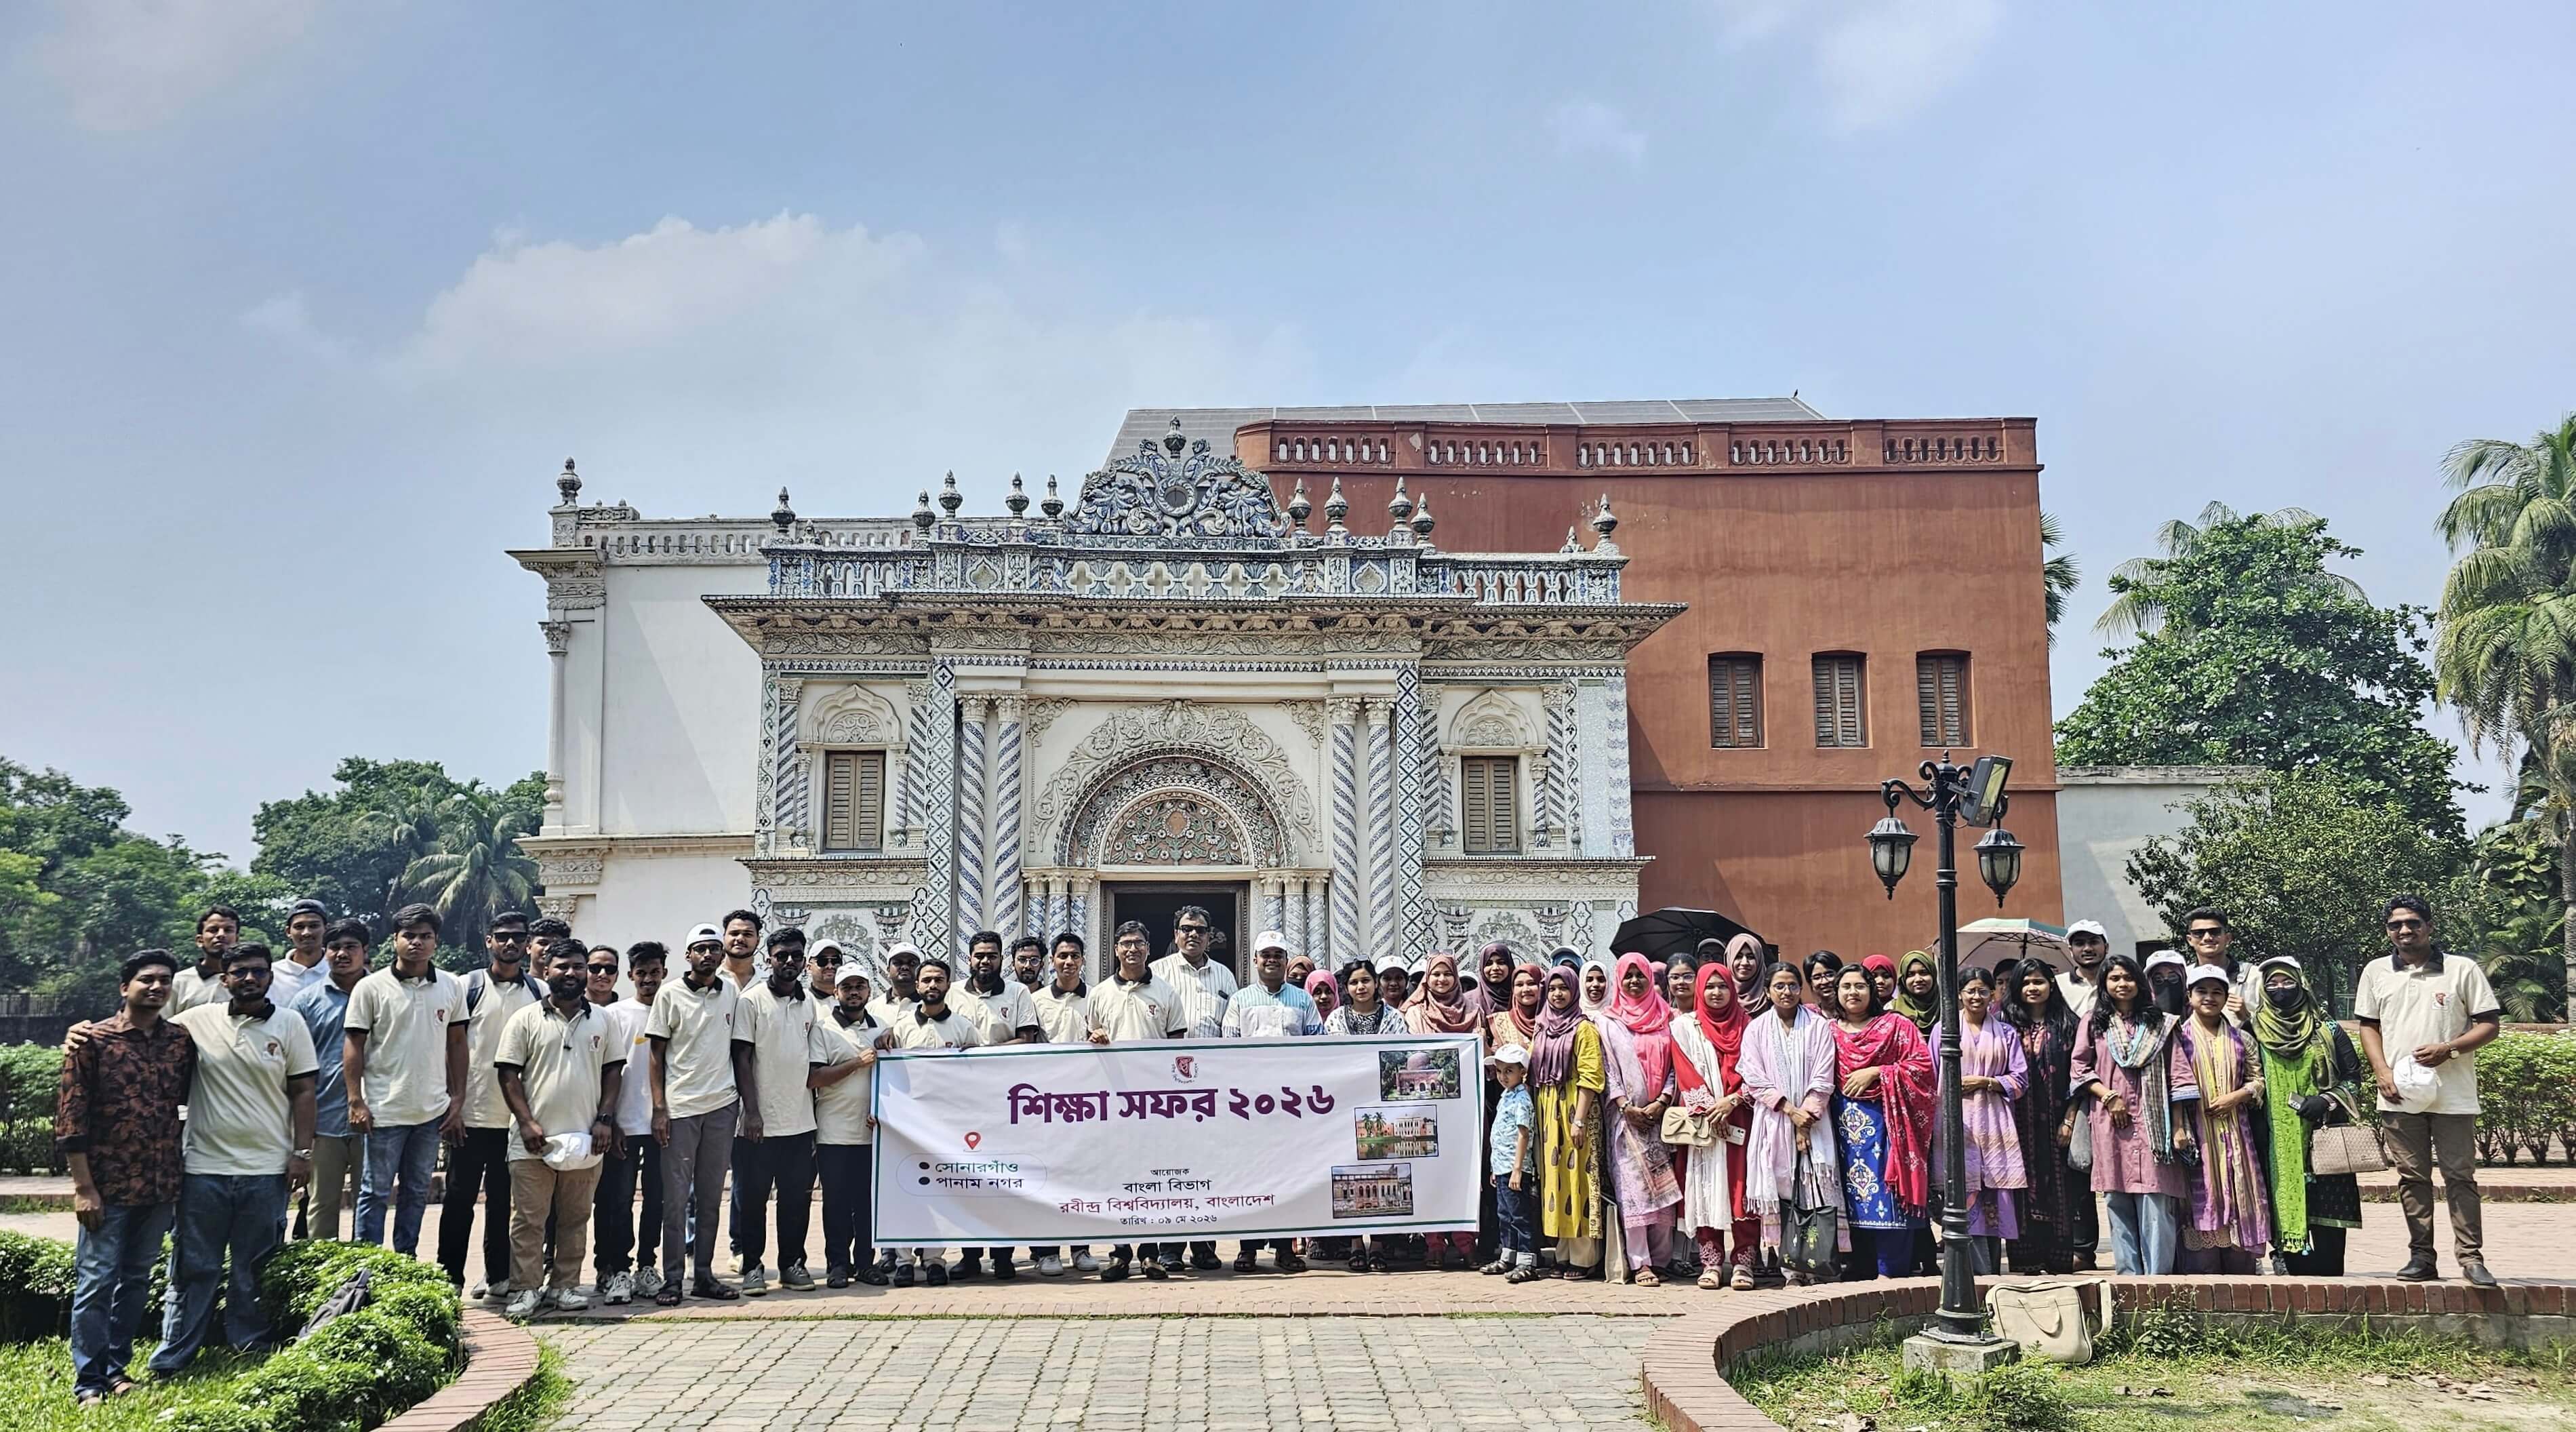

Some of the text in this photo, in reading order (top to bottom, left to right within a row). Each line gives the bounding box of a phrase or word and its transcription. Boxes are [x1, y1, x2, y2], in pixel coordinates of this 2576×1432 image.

[1007, 1083, 1335, 1124] শিক্ষা সফর ২০২৬
[935, 1159, 1019, 1174] সোনারগাঁও
[1150, 1168, 1190, 1176] আয়োজক
[935, 1177, 1024, 1189] পানাম নগর
[1123, 1178, 1212, 1193] বাংলা বিভাগ
[1059, 1194, 1275, 1214] রবীন্দ্র বিশ্ববিদ্যালয়, বাংলাদেশ
[1120, 1215, 1148, 1226] তারিখ
[1190, 1214, 1217, 1223] ২০২৬
